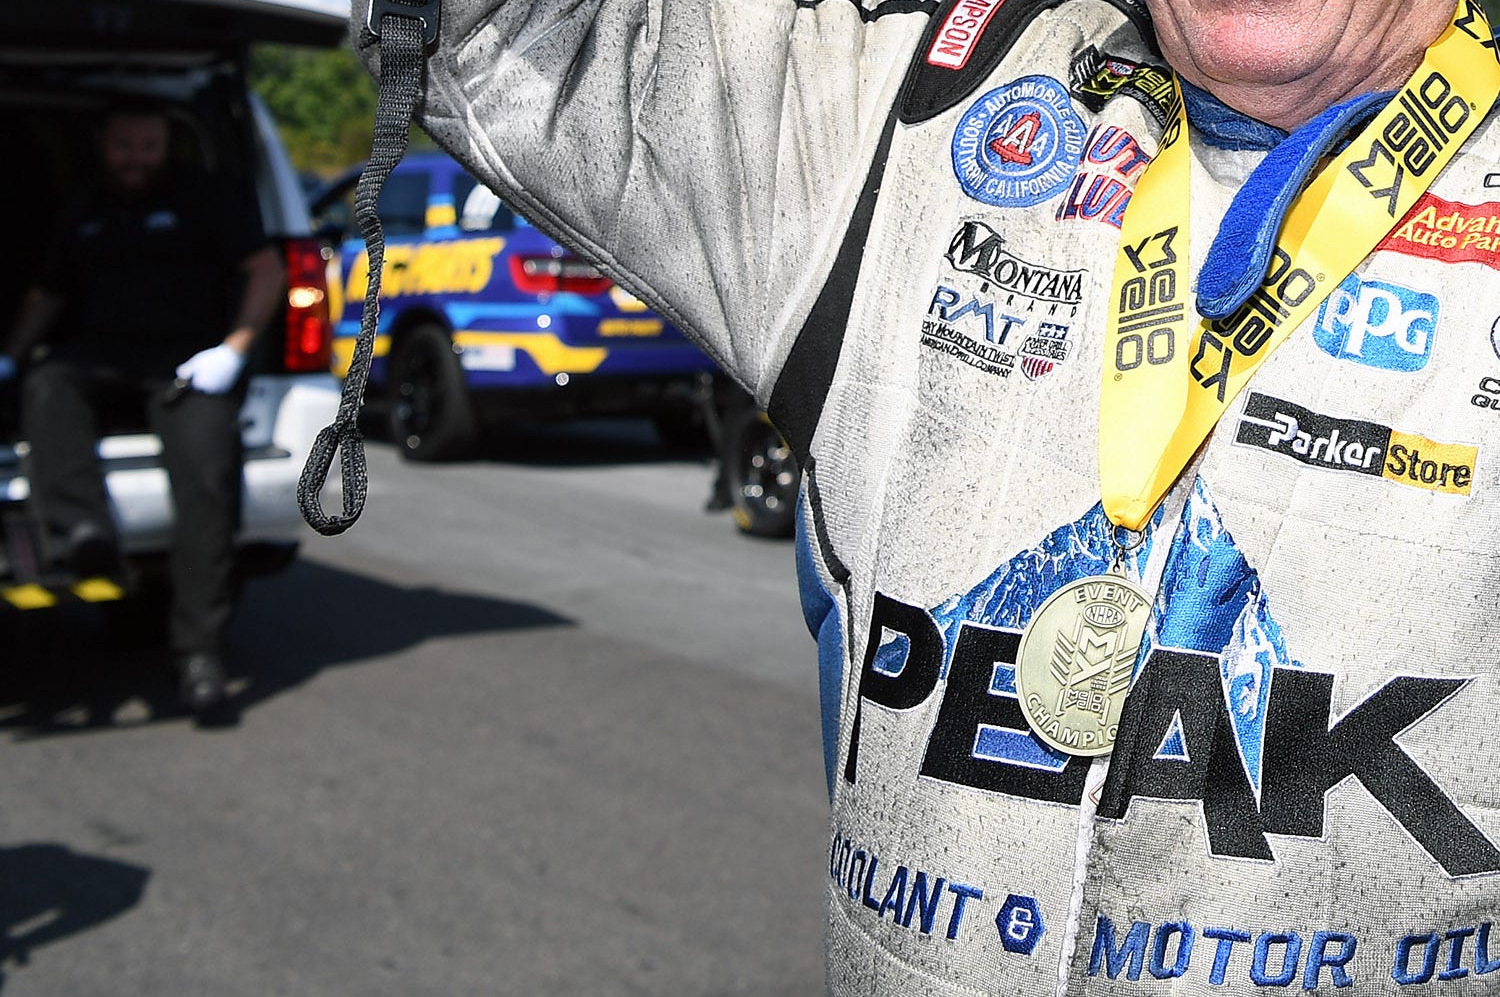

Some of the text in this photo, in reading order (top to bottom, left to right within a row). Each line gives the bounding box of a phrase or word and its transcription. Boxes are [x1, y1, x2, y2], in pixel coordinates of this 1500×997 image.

[984, 80, 1072, 121] AUTOMOBILE
[1063, 117, 1083, 155] CLUB
[990, 112, 1049, 159] AAA
[1347, 72, 1451, 188] Mello
[958, 117, 1073, 200] SOUTHERN CALIFORNIA
[1369, 95, 1470, 219] Yello
[947, 221, 1083, 301] MONTANA
[1391, 221, 1459, 252] Auto
[928, 285, 1028, 346] RMT
[1325, 288, 1434, 359] PPG
[1074, 583, 1143, 613] EVENT
[1086, 607, 1121, 624] NHRA
[1027, 692, 1119, 748] CHAMPIO
[1089, 916, 1357, 991] MOTOR
